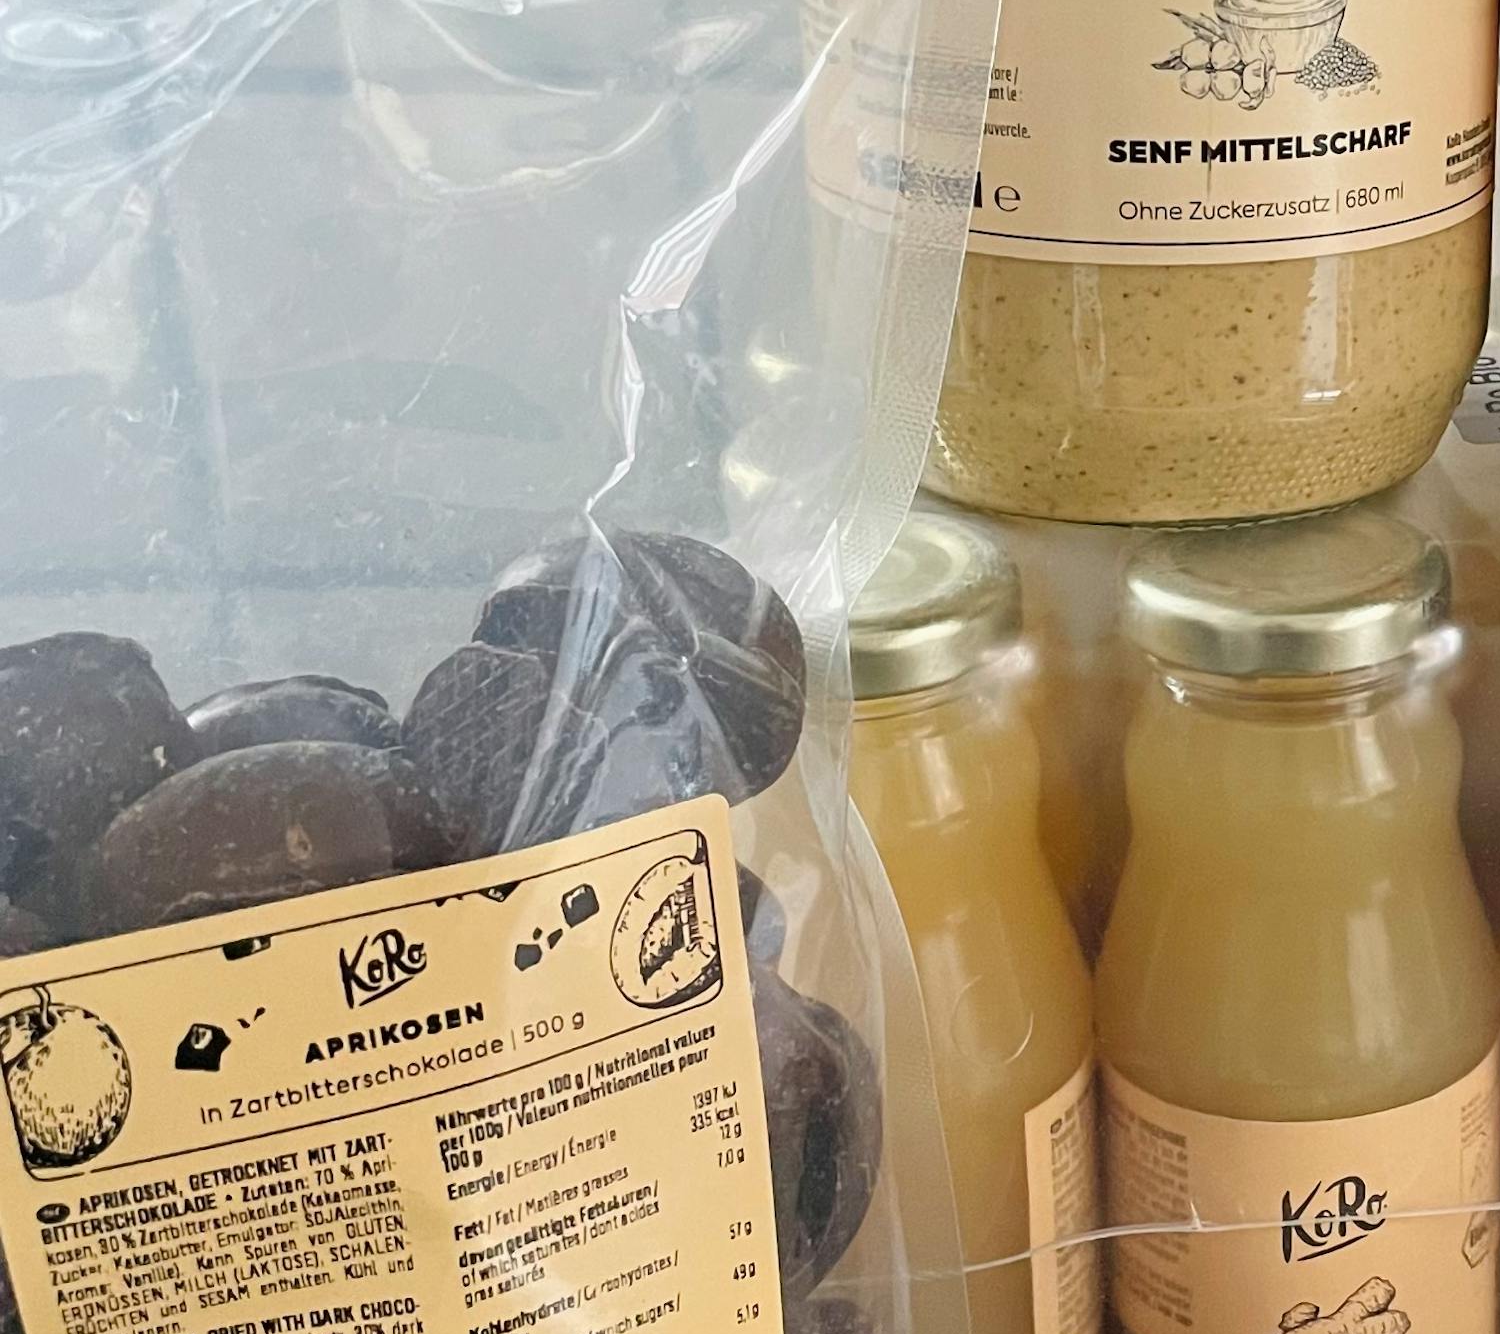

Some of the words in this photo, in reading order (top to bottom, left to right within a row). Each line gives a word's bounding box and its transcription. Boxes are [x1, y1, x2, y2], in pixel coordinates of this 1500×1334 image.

[1108, 140, 1192, 163] SENF
[1201, 121, 1411, 165] MITTELSCHARF
[1119, 196, 1182, 220] Ohne
[1189, 196, 1329, 220] Zuckerzusatz
[1346, 187, 1379, 208] 680
[1385, 181, 1403, 201] ml
[339, 929, 427, 1009] KoRo
[305, 1003, 485, 1064] APRIKOSEN
[229, 1035, 506, 1122] Zartbitterschokolade
[524, 1016, 564, 1043] 500
[572, 1012, 584, 1037] g
[690, 1110, 712, 1132] 335
[693, 1087, 718, 1109] 1397
[80, 1179, 183, 1215] APRIKOSEN,
[189, 1152, 298, 1191] GETROCKNET
[308, 1144, 336, 1166] MIT
[344, 1133, 392, 1158] ZART-
[41, 1193, 218, 1245] BITTERSCHOKOLADE
[454, 1220, 484, 1241] Fett
[1280, 1176, 1387, 1263] KoRo
[175, 1271, 226, 1295] MILCH
[329, 1238, 411, 1262] SCHALEN-
[198, 1285, 250, 1309] SESAM
[261, 1313, 305, 1334] WITH
[310, 1306, 355, 1327] DARK
[360, 1298, 420, 1327] CHOCO-
